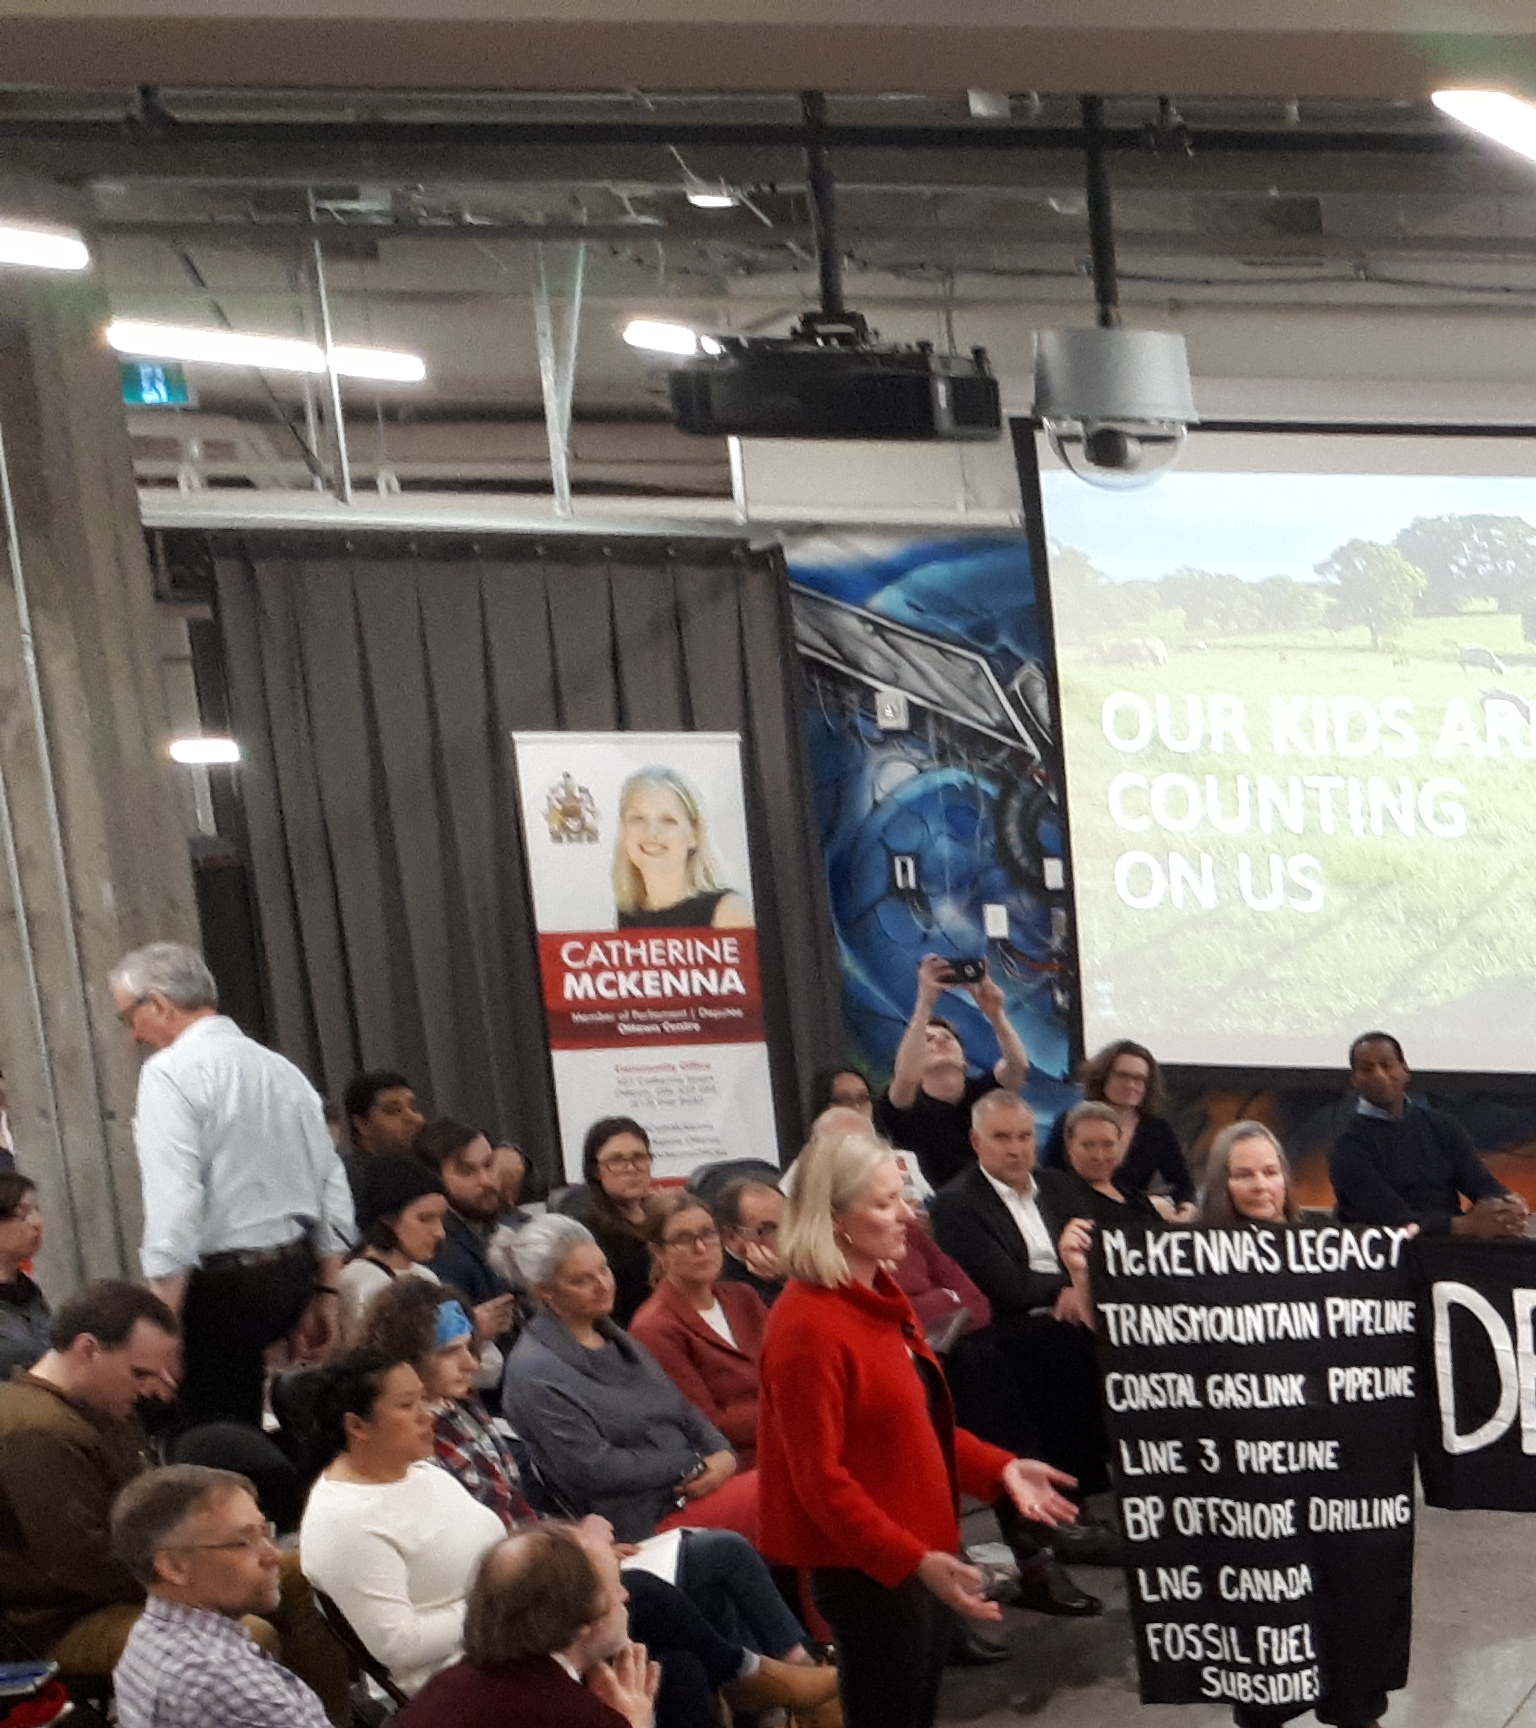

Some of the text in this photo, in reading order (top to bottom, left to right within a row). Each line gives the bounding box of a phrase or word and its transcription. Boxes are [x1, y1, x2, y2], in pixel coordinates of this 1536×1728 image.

[1101, 691, 1250, 753] OUR
[1271, 694, 1420, 757] KIDS
[1107, 772, 1469, 838] COUNTING
[1114, 850, 1326, 913] ON US
[560, 936, 740, 969] CATHERINE
[563, 967, 747, 1001] MCKENNA
[1102, 1225, 1405, 1277] McKENNA'S LEGACY
[1098, 1296, 1416, 1347] TRANSMOUNTAIN PIPELINE
[1106, 1364, 1416, 1412] COASTAL GASLINK PIPELINE
[1119, 1438, 1340, 1476] LINE 3 PIPELINE
[1122, 1494, 1411, 1541] BP OFFSHORE DRILLING
[1138, 1563, 1312, 1602] LNG CANADA
[1145, 1622, 1317, 1666] FOSSIL FUEL
[1200, 1664, 1322, 1705] SUBSIDIES
